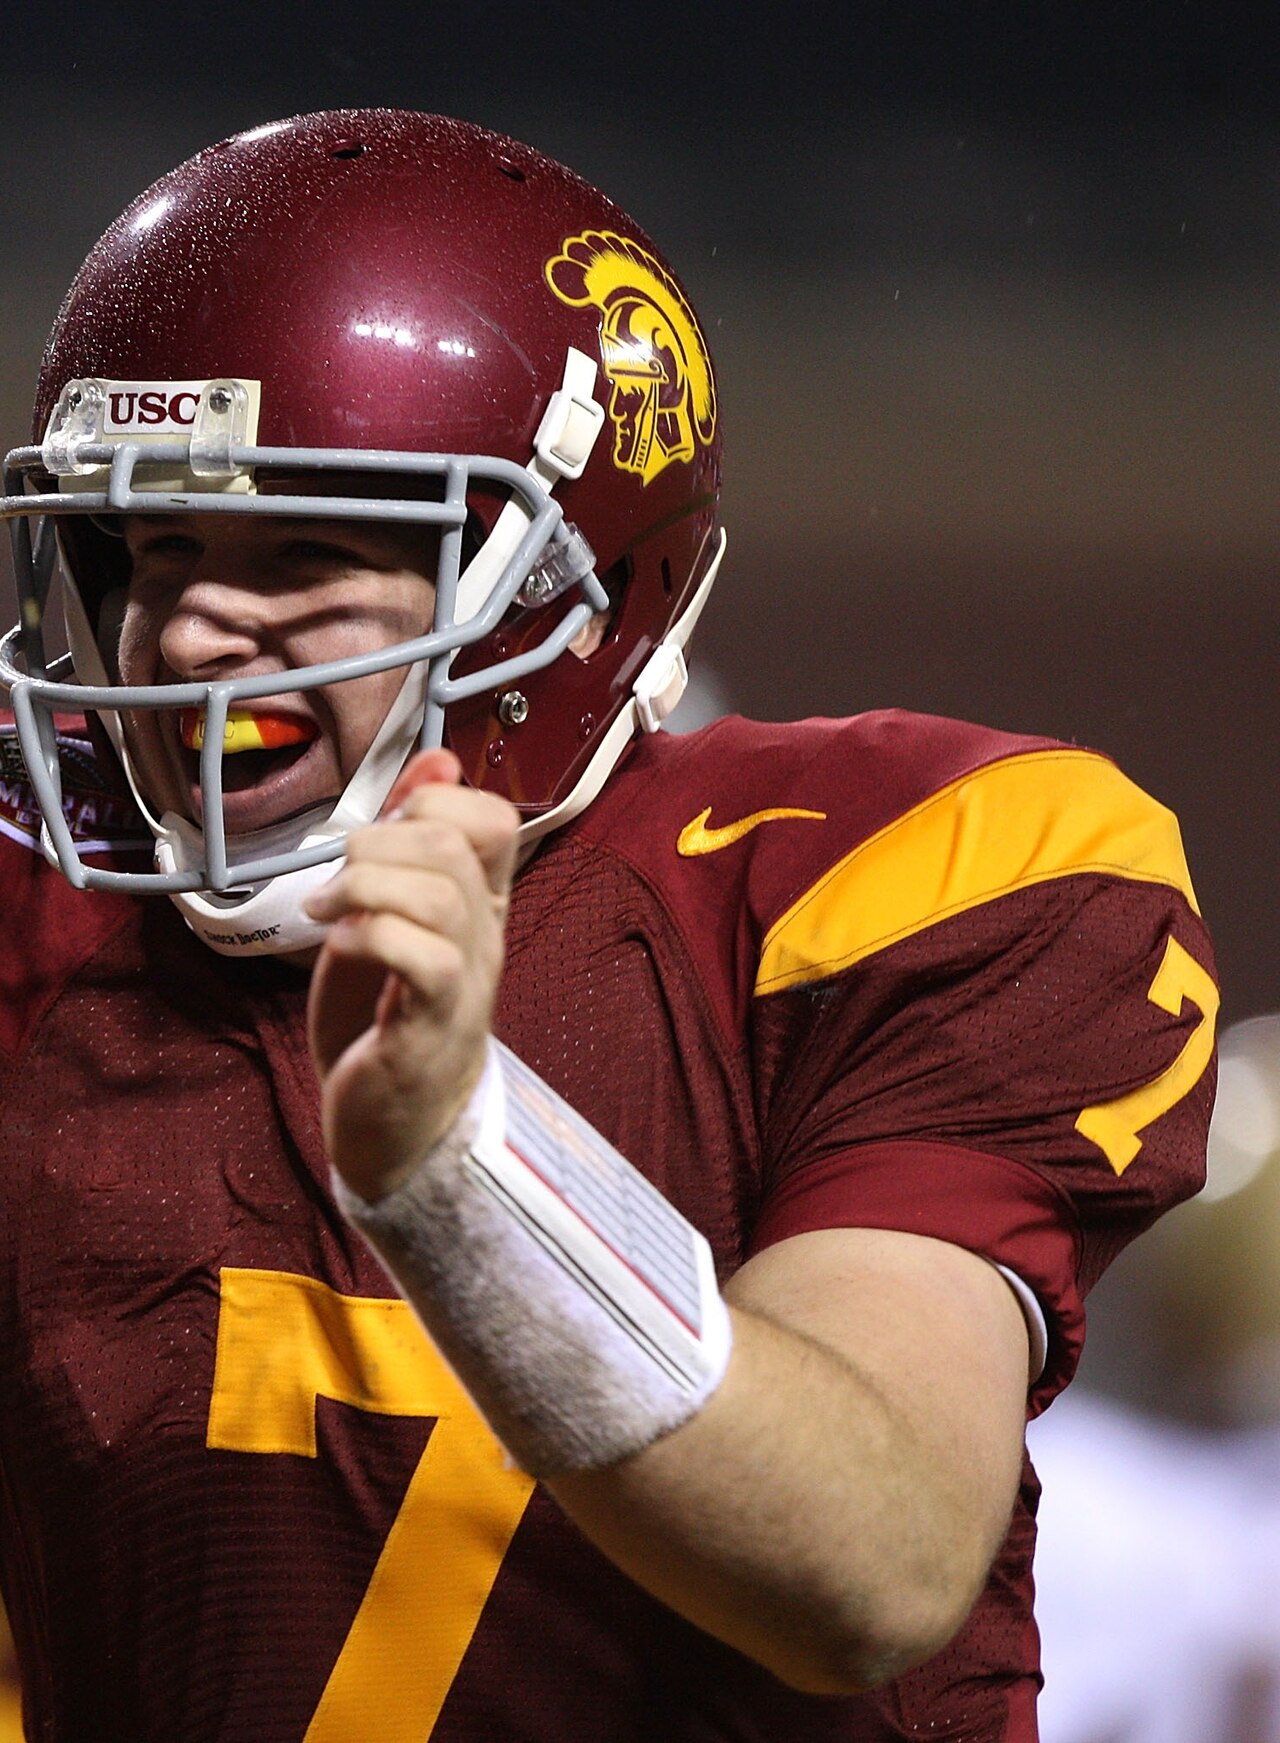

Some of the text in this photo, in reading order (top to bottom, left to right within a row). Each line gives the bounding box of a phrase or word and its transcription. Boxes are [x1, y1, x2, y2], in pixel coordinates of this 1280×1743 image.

[108, 392, 201, 425] USC
[1074, 934, 1221, 1177] 7
[206, 1266, 538, 1743] 7
